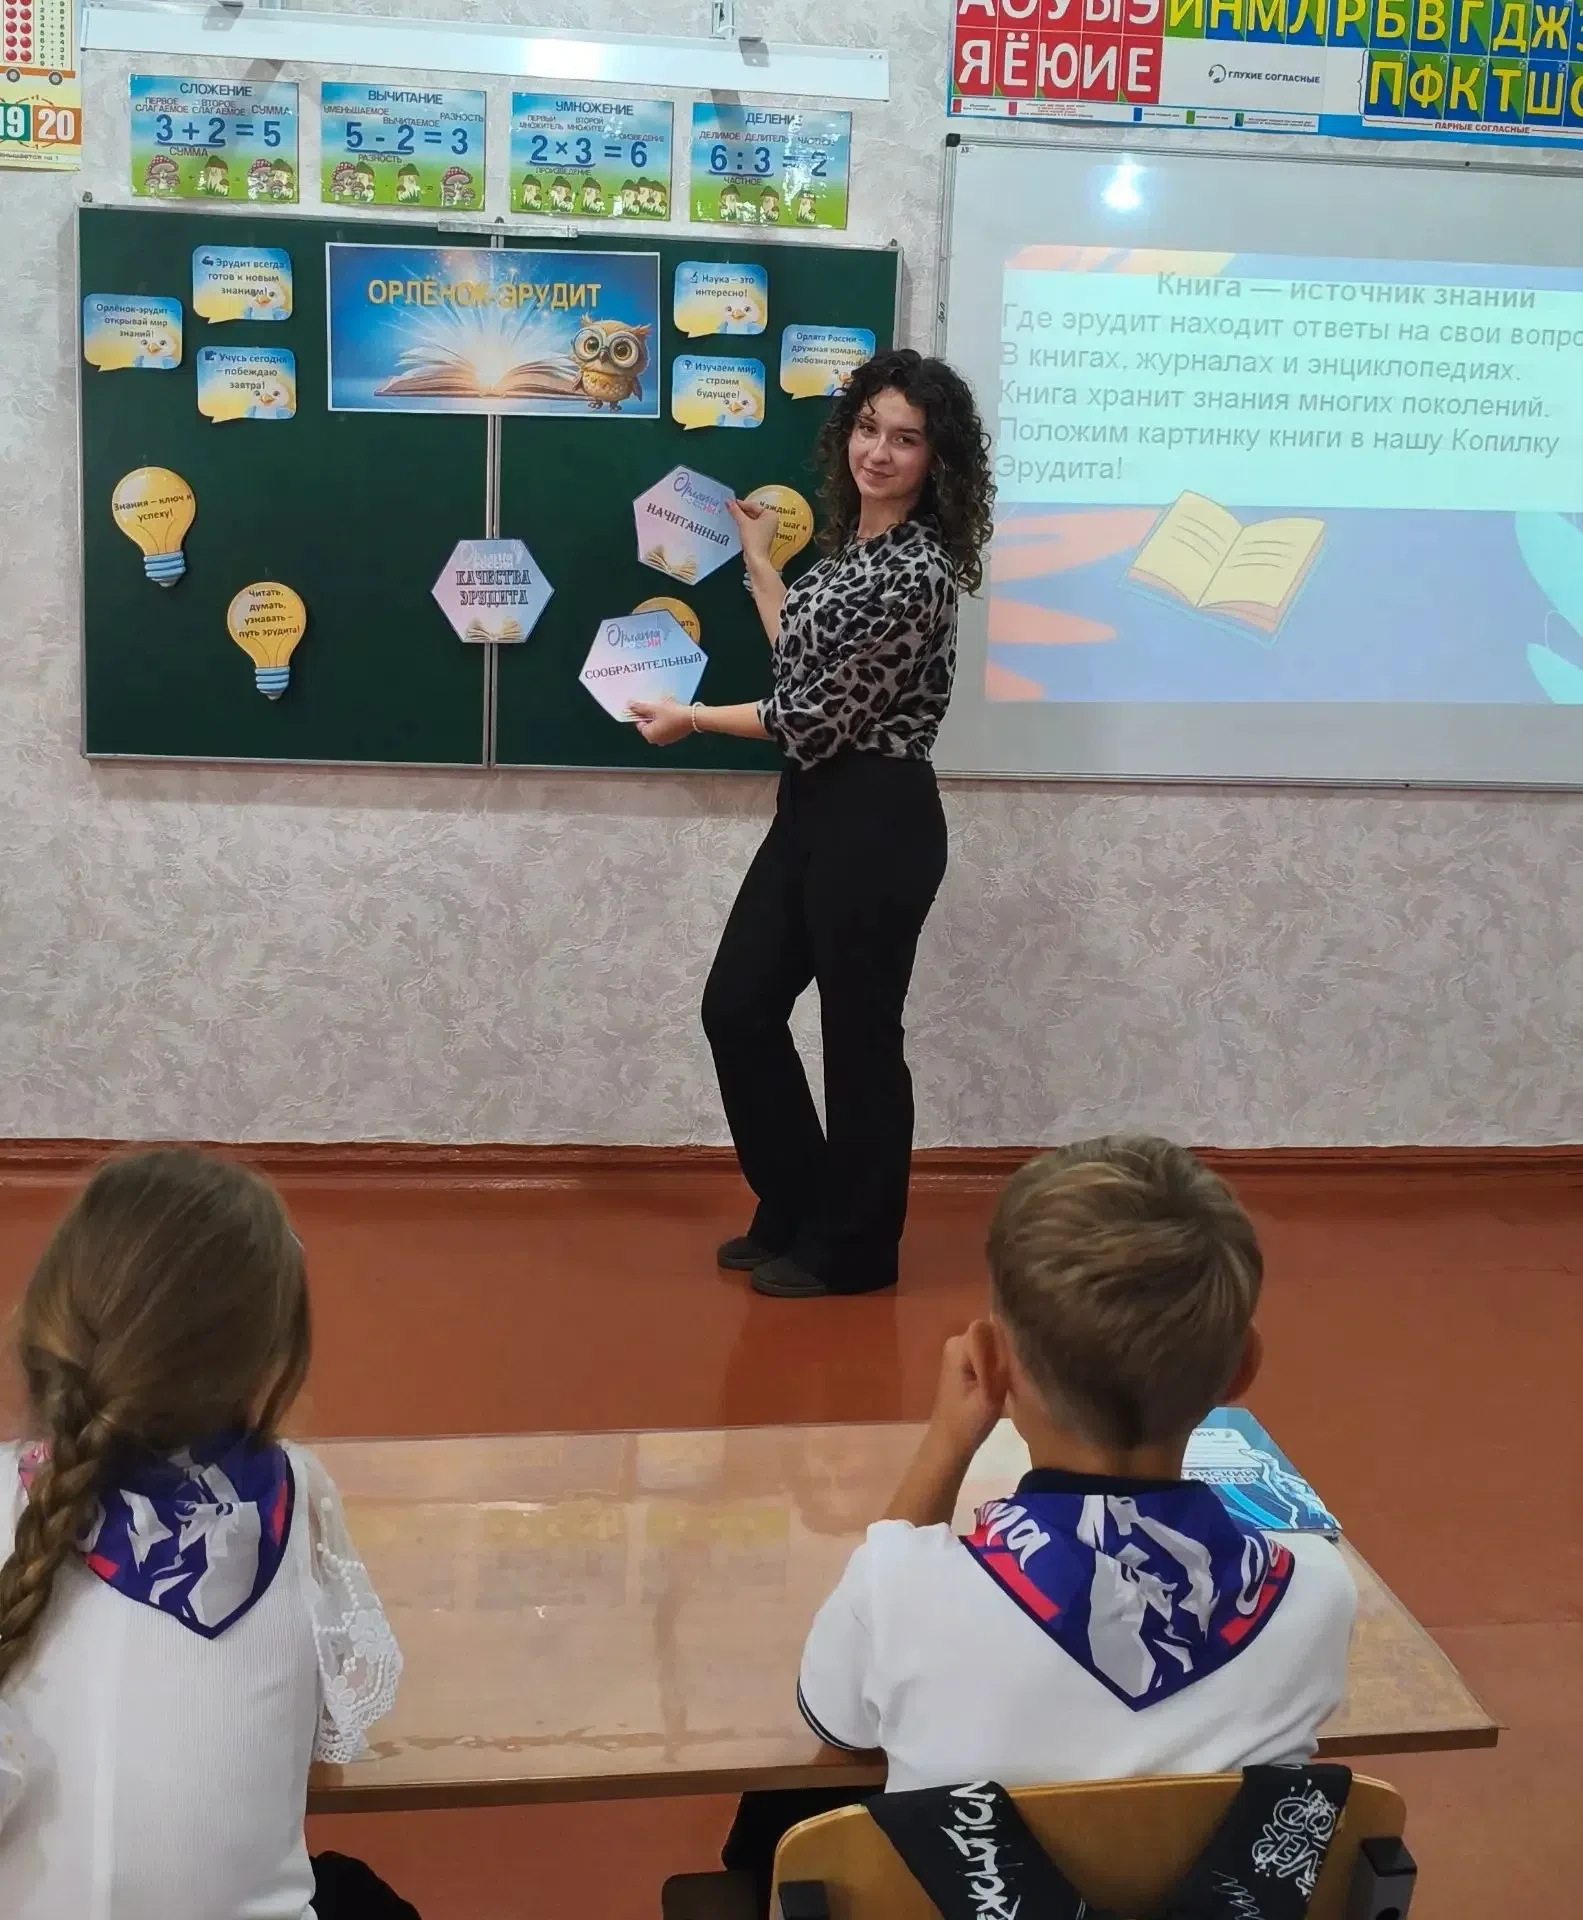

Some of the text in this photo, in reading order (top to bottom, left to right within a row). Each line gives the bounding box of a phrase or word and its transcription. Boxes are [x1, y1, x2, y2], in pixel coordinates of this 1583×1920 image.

[1228, 70, 1320, 84] ГЛУХИЕ СОГЛАСНЫЕ
[180, 82, 252, 97] СЛОЖЕНИЕ
[145, 97, 180, 105] ПЕРВОЕ
[201, 99, 236, 107] ВТОРОЕ
[368, 90, 443, 105] ВЫЧИТАНИЕ
[135, 104, 189, 113] СЛАГАЕМОЕ
[192, 106, 246, 116] СЛАГАЕМОЕ
[251, 105, 291, 116] СУММА
[323, 105, 390, 115] УМЕНЬШАЕМОЕ
[555, 101, 634, 116] УМНОЖЕНИЕ
[383, 117, 440, 127] ВЫЧИТАЕМОЕ
[440, 112, 484, 122] РАЗНОСТЬ
[38, 108, 74, 141] 20
[567, 124, 607, 132] МНОЖИТЕ
[1434, 121, 1530, 134] ПАРНЫЕ СОГЛАСНЫЕ
[156, 114, 174, 142] 3
[208, 117, 226, 144] 2
[263, 121, 281, 147] 5
[699, 131, 740, 141] ДЕЛИМОЕ
[346, 121, 363, 148] 5
[397, 124, 414, 150] 2
[451, 128, 468, 155] 3
[744, 133, 789, 143] ДЕЛИТЕЛЬ
[169, 146, 208, 157] СУММА
[531, 135, 548, 161] 2
[575, 137, 592, 164] 3
[630, 141, 647, 168] 6
[358, 154, 402, 163] РАЗНОСТЬ
[710, 144, 728, 171] 6
[754, 147, 770, 173] 3
[811, 151, 827, 177] 2
[535, 167, 592, 176] ПРОИЗВЕДЕНИЕ
[723, 177, 762, 186] ЧАСТНОЕ
[215, 258, 285, 270] Эрудит всегда
[208, 273, 234, 281] готов
[245, 273, 279, 282] новым
[702, 274, 755, 286] Наука это
[695, 289, 748, 299] интересно!
[1157, 272, 1242, 298] Книга
[1290, 282, 1426, 305] источник
[104, 317, 168, 328] открывай мир
[1002, 303, 1053, 333] Где
[1062, 311, 1161, 336] эрудит
[1170, 315, 1284, 340] находит
[1293, 319, 1389, 340] ответы
[1398, 323, 1429, 341] на
[1440, 325, 1501, 344] свои
[797, 332, 826, 341] Орлята
[219, 353, 247, 364] Учусь
[1000, 341, 1521, 382] В книгах, журналах и энциклопедиях.
[224, 367, 278, 377] побеждаю
[695, 362, 757, 375] Изучаем мир
[229, 381, 266, 390] завтра!
[706, 377, 739, 387] строим
[697, 389, 740, 399] будущее!
[999, 380, 1550, 419] Книга хранит знания многих поколений.
[999, 417, 1560, 459] Положим картинку книги в нашу Копилку
[995, 454, 1124, 484] Эрудита!
[114, 499, 149, 511] Знания
[159, 495, 184, 505] ключ
[137, 509, 174, 523] успеху!
[646, 503, 730, 547] НАЧИТАННЫЙ
[783, 521, 800, 530] шаг
[456, 570, 531, 585] КАЧЕСТВА
[460, 590, 528, 608] ЭРУДИТА
[244, 615, 286, 625] узнавать
[238, 625, 300, 639] путь эрудита!
[585, 651, 702, 680] СООБРАЗИТЕЛЬНЫЙ
